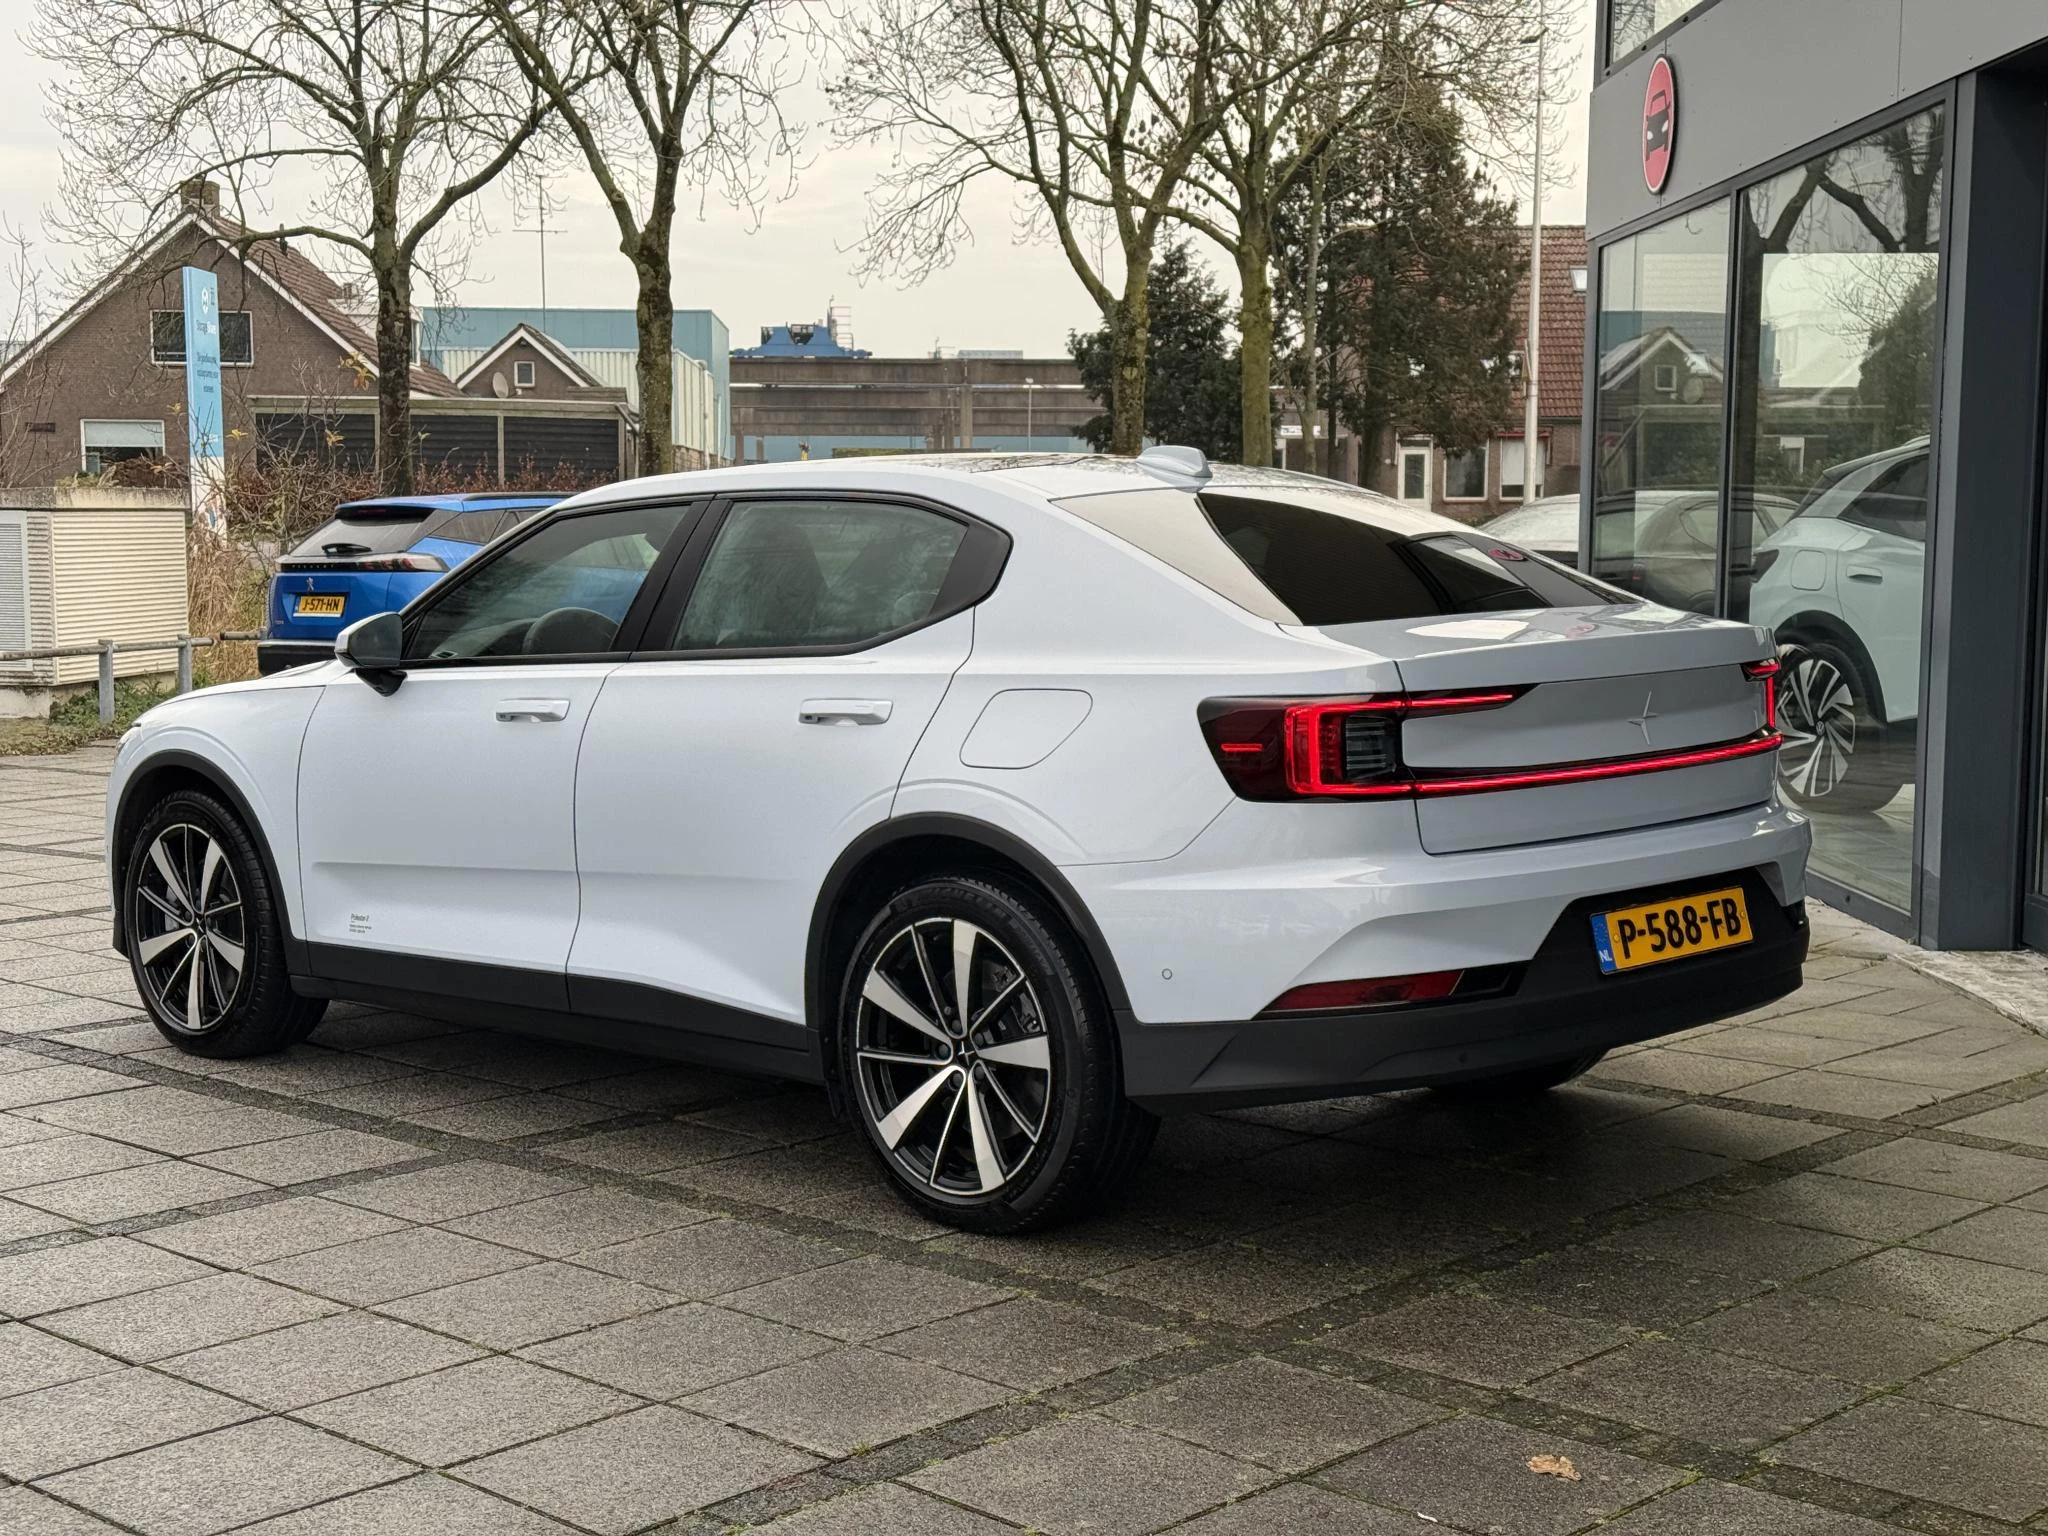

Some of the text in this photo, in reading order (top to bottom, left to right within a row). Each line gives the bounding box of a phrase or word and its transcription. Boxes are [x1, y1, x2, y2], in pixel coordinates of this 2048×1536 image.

[302, 598, 340, 611] J-571-HN
[1617, 898, 1741, 960] P-588-FB
[1599, 949, 1613, 963] NL
